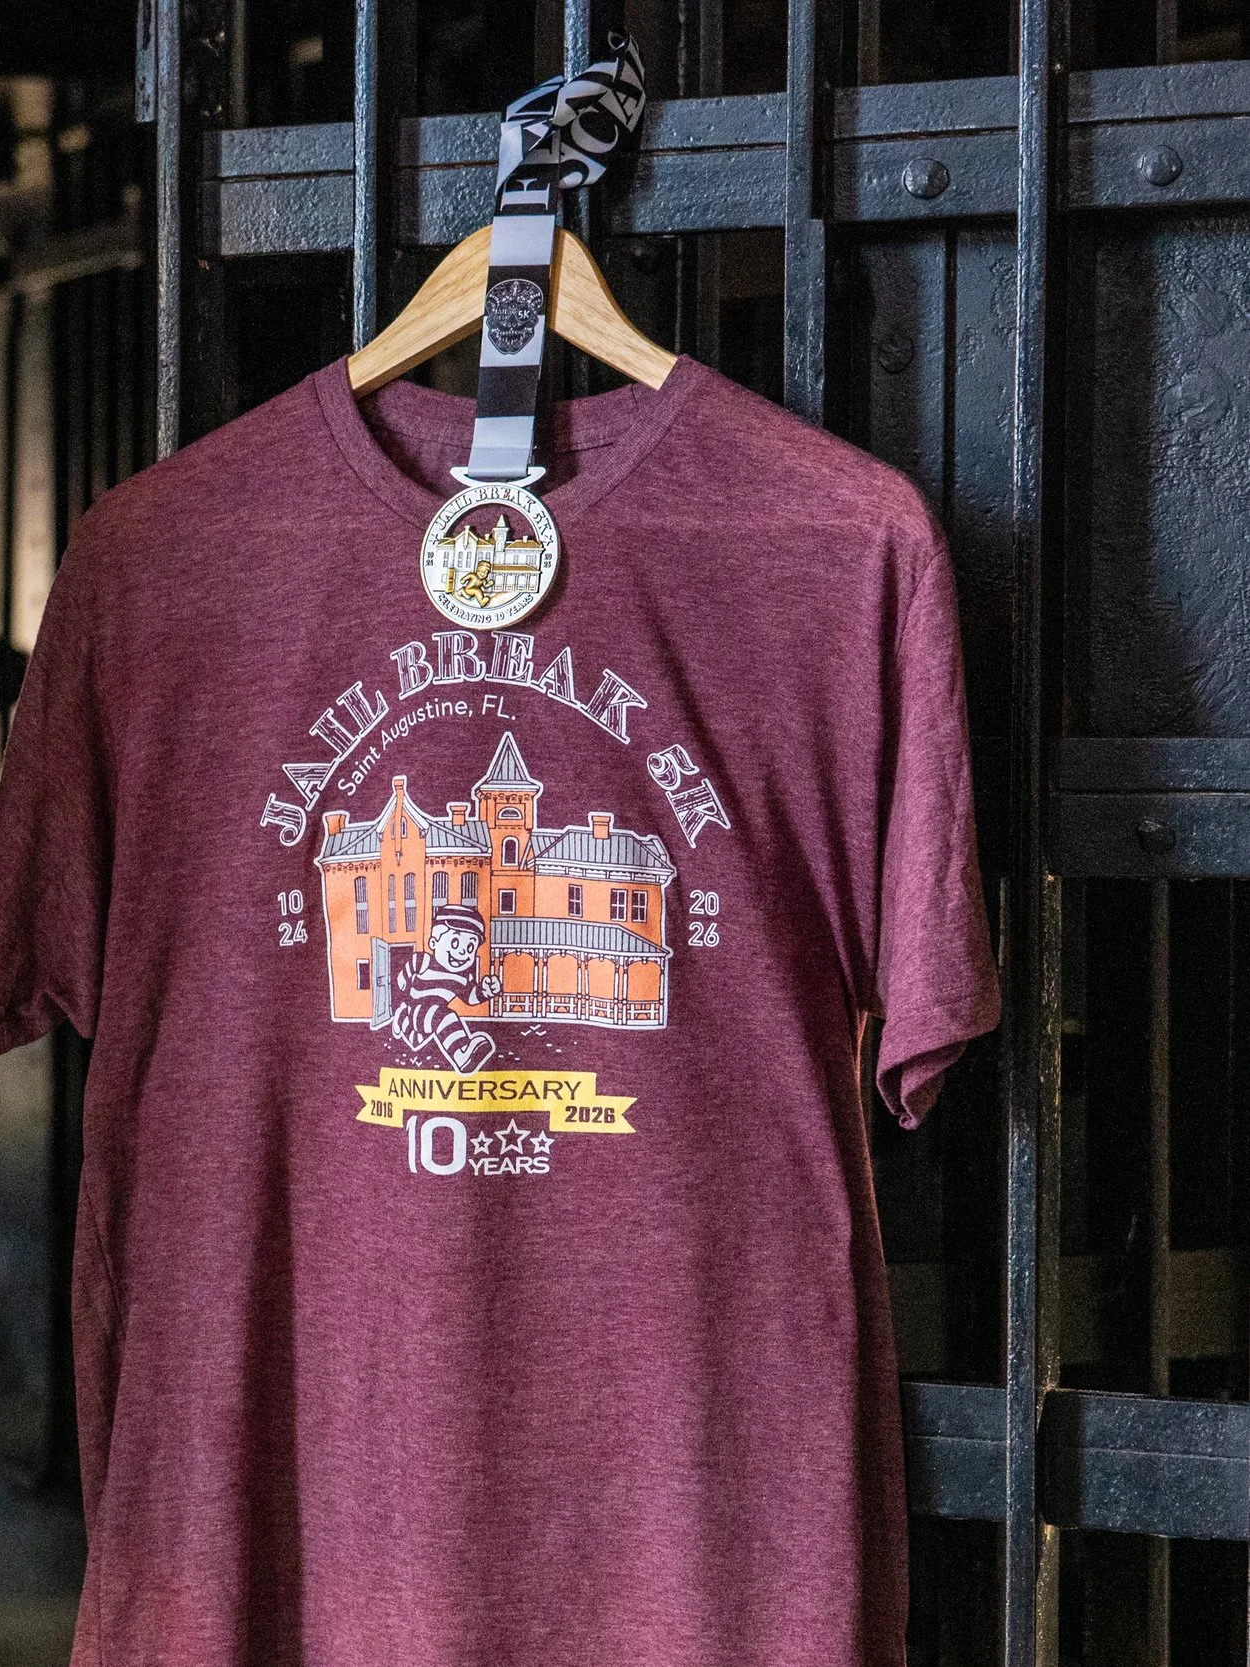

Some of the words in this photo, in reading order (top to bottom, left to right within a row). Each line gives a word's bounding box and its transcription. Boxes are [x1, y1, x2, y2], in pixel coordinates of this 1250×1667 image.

[518, 310, 530, 319] 5K
[436, 495, 473, 531] JAIL
[475, 486, 536, 513] BREAK
[533, 511, 552, 535] 5K
[438, 592, 492, 624] CELEBRATING
[495, 612, 505, 622] 10
[507, 593, 534, 616] YEARS
[260, 681, 390, 847] JAIL
[390, 630, 648, 744] BREAK
[647, 743, 731, 849] 5K
[337, 745, 381, 796] Saint
[380, 698, 473, 750] Augustine,
[481, 694, 517, 721] FL.
[277, 889, 304, 916] 10
[689, 889, 720, 916] 20
[278, 920, 308, 947] 24
[688, 921, 720, 947] 26
[388, 1077, 582, 1101] ANNIVERSARY
[370, 1100, 393, 1118] 2016
[565, 1105, 616, 1124] 2026
[405, 1114, 468, 1176] 10
[468, 1157, 550, 1176] YEARS
